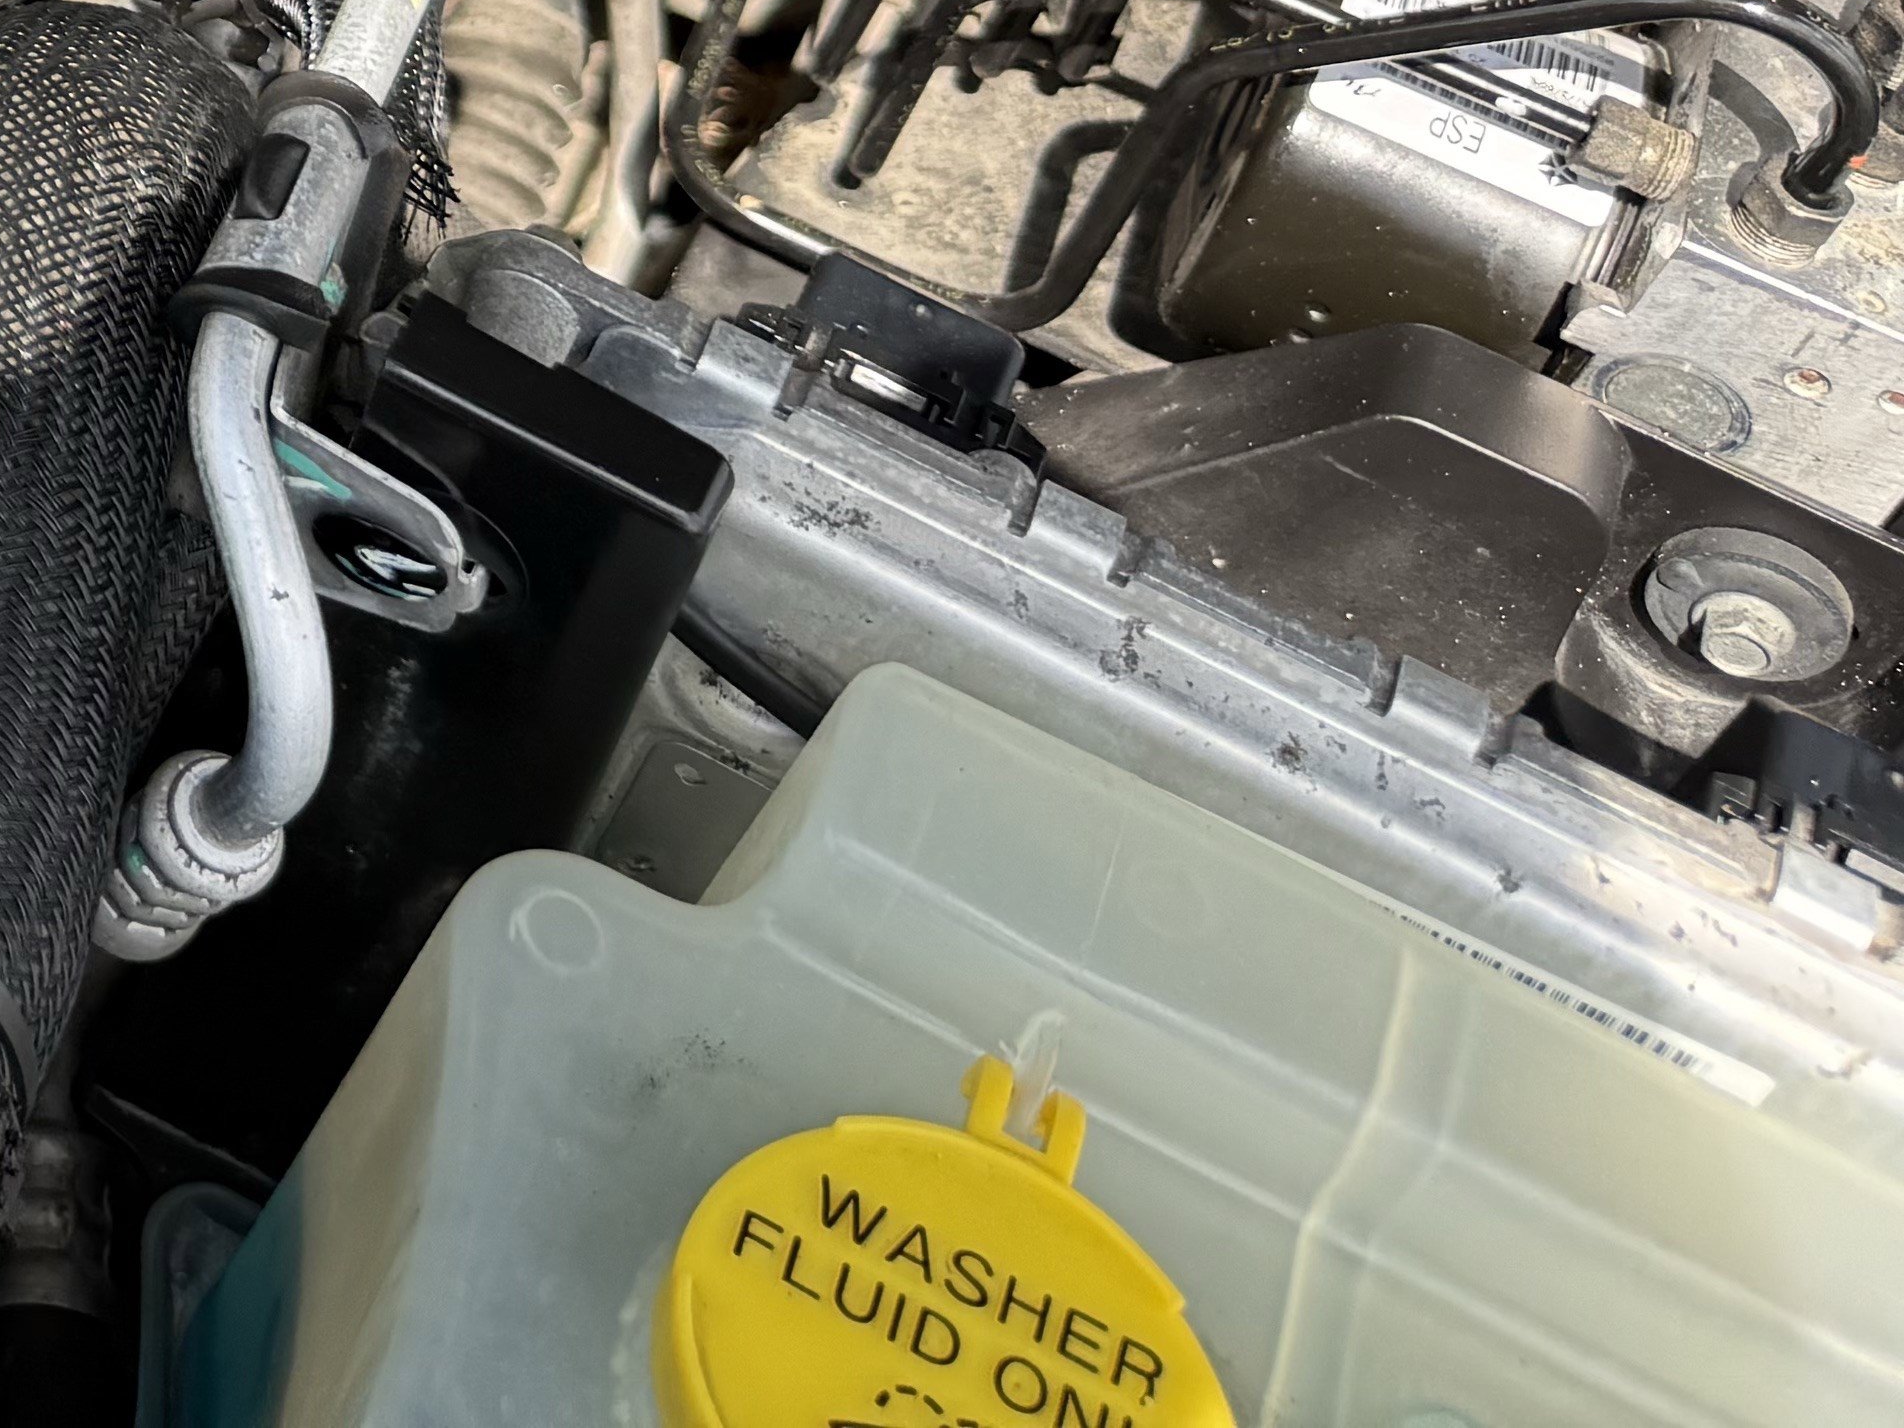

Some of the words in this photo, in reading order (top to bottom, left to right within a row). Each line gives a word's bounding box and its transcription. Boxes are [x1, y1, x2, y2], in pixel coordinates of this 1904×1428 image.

[1429, 111, 1487, 154] ESP
[732, 1209, 962, 1367] FLUID
[993, 1355, 1134, 1428] ON
[820, 1173, 1165, 1407] WASHER
